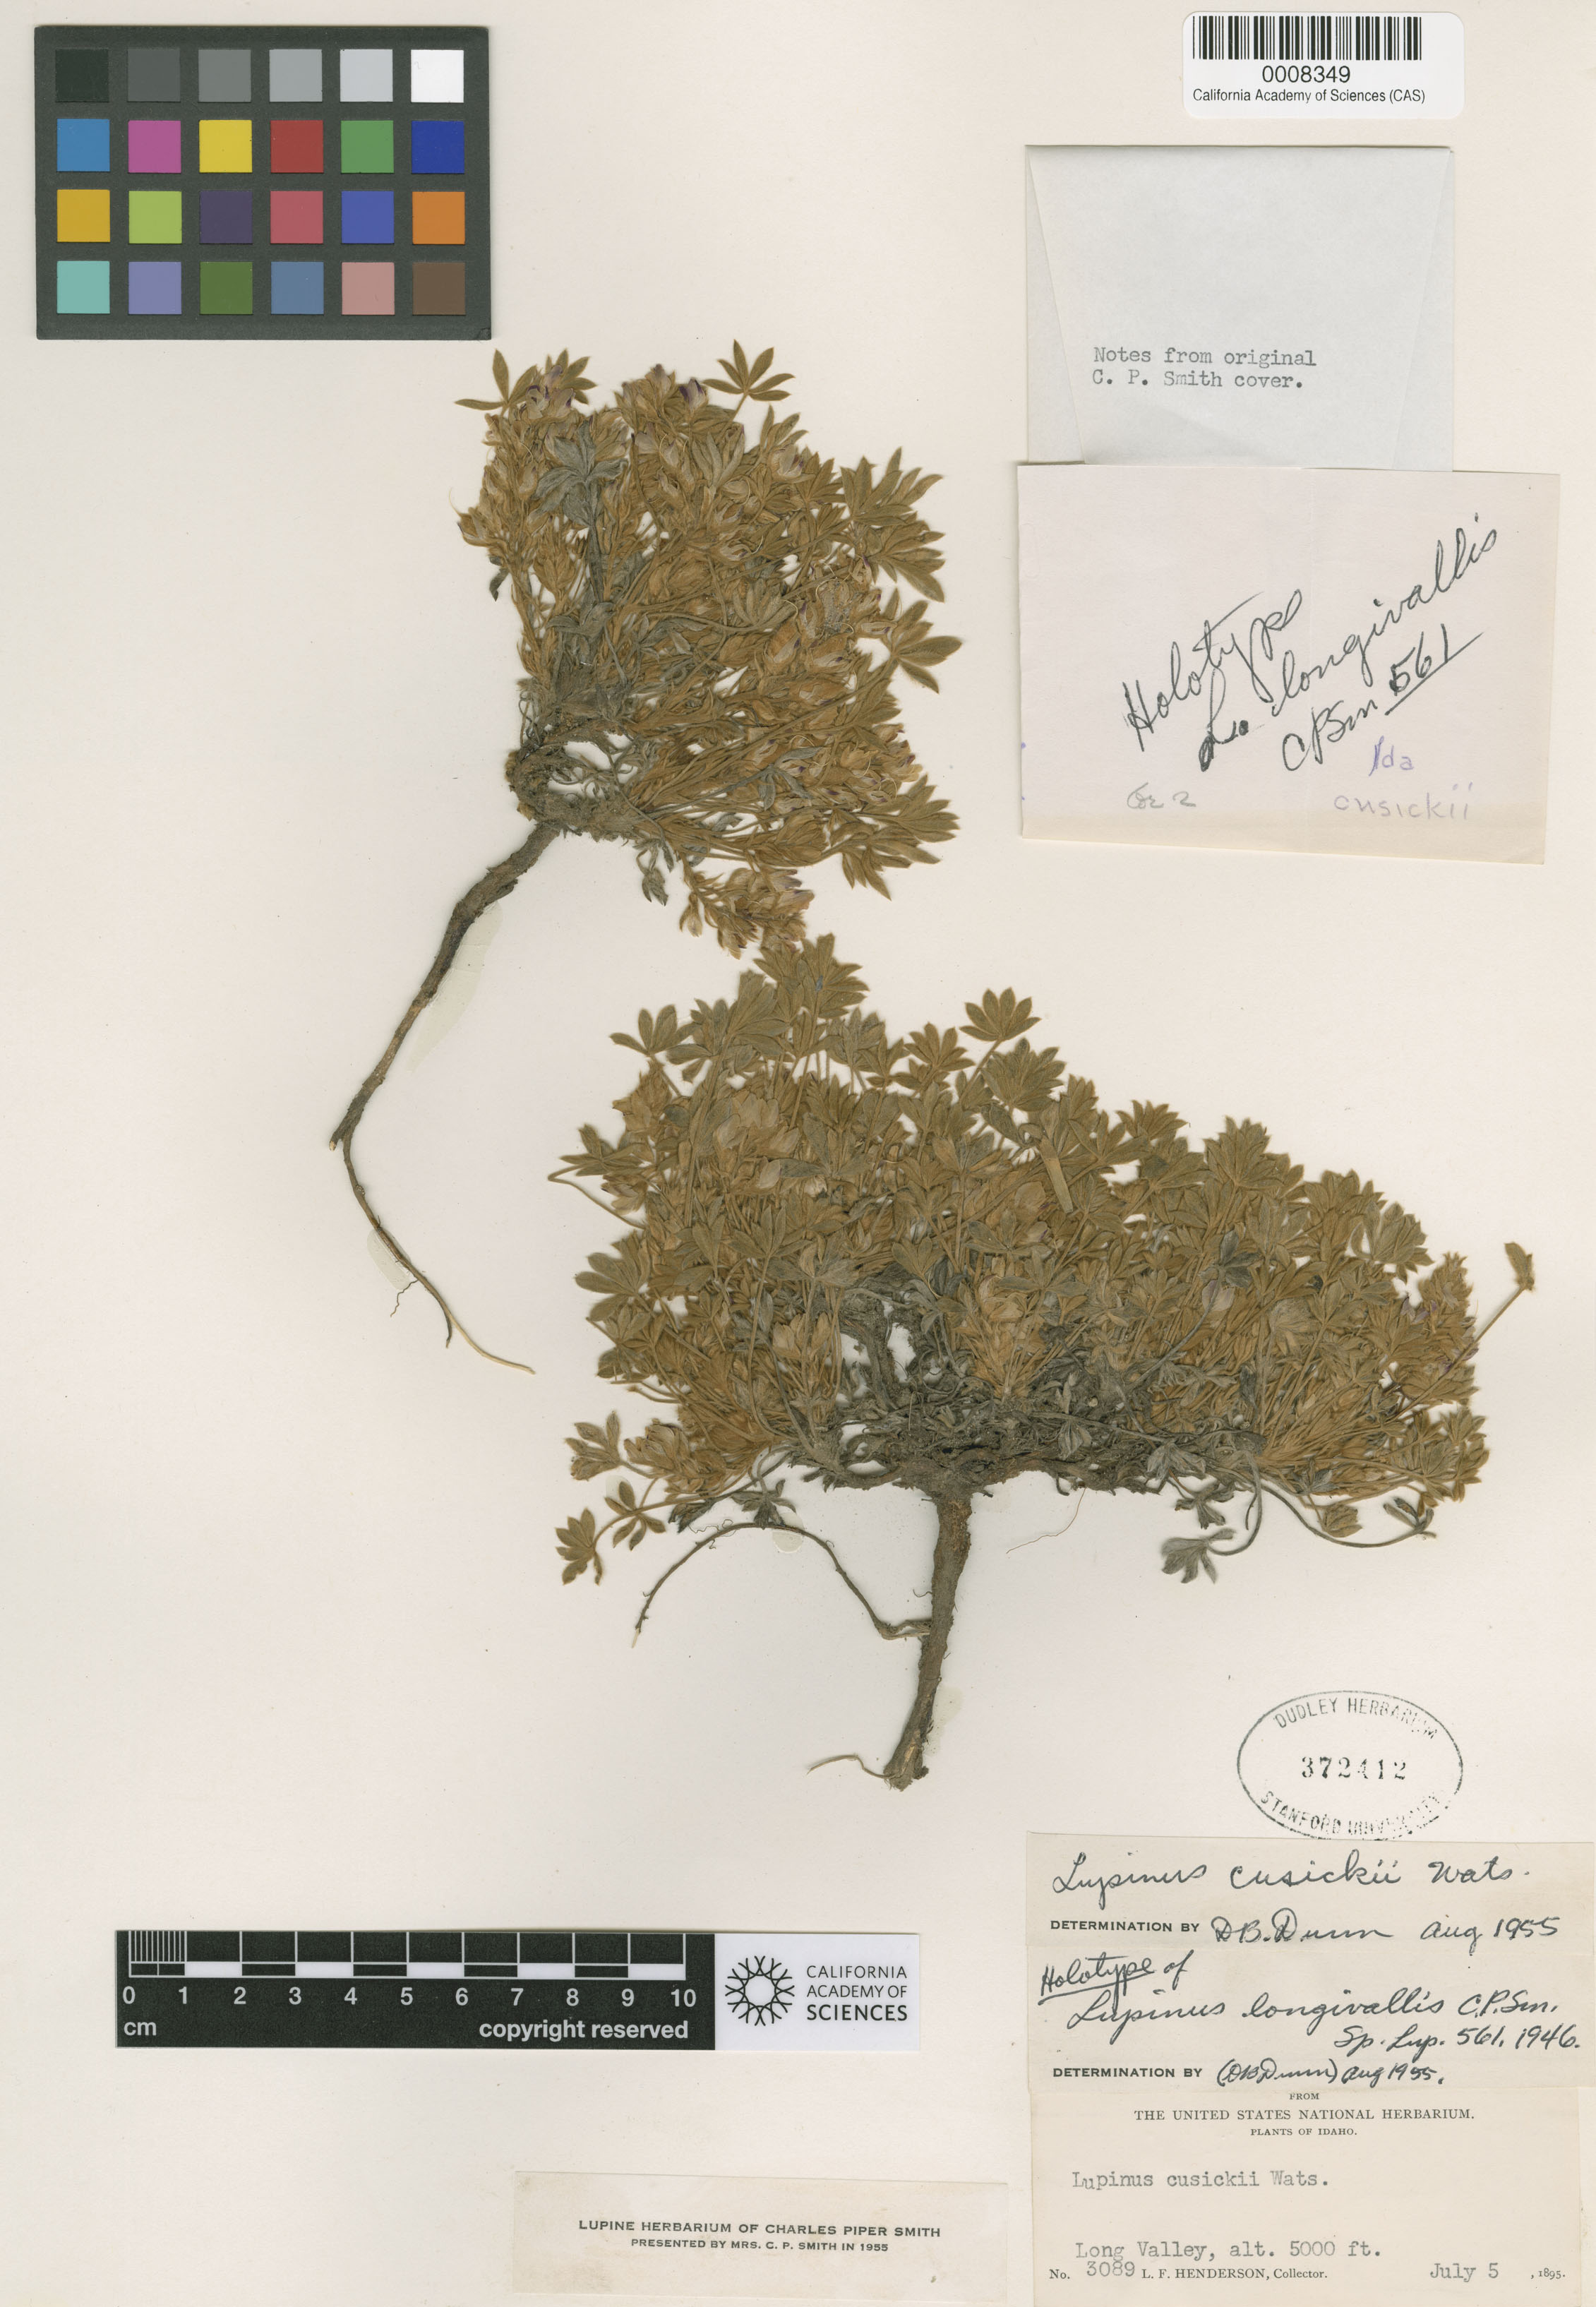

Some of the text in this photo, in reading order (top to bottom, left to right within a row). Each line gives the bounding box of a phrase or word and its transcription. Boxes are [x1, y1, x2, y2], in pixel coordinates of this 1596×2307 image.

[1261, 65, 1351, 83] 0008349
[1193, 88, 1425, 104] California Academy of Sciences (CAS)
[1093, 346, 1317, 369] Notes from original
[1092, 368, 1303, 389] C. P. Smith cover.
[1271, 512, 1498, 717] longivallis
[1388, 622, 1449, 696] 561
[1121, 589, 1303, 753] Holotype
[1273, 1697, 1338, 1729] DUDLEY
[1260, 1790, 1341, 1835] STANFORD
[1052, 1852, 1207, 1911] Lupinus
[1050, 1920, 1200, 1932] DETERMINATION BY
[1493, 1916, 1561, 1941] 1955
[806, 1965, 907, 1979] CALIFORNIA
[1040, 1948, 1194, 2013] Holotype of
[122, 1985, 697, 2008] 0 1 2 3 4 5 6 7 8 9 10
[806, 1984, 908, 1999] ACADEMY OF
[807, 2003, 908, 2022] SCIENCES
[1067, 1989, 1226, 2045] Lupinus
[1241, 1987, 1445, 2039] longivallis
[124, 2019, 688, 2042] cm copyright reserved
[1052, 2067, 1203, 2078] DETERMINATION BY
[1134, 2109, 1475, 2121] THE UNITED STATES NATIONAL HERBARIUM.
[1072, 2170, 1328, 2191] Lupinus cusickii Wats.
[579, 2219, 940, 2237] LUPINE HERBARIUM OF CHARLES PIPER SMITH
[631, 2239, 889, 2252] PRESENTED BY MRS. C. P. SMITH IN 1955
[1075, 2240, 1381, 2263] Long Valley, alt. 5000 ft.
[1049, 2269, 1070, 2279] No.
[1086, 2260, 1136, 2277] 3089
[1141, 2268, 1154, 2279] L.
[1158, 2268, 1170, 2279] F.
[1175, 2268, 1270, 2281] HENDERSON,
[1273, 2267, 1328, 2279] Collector.
[1429, 2263, 1477, 2283] July
[1488, 2262, 1499, 2279] 5
